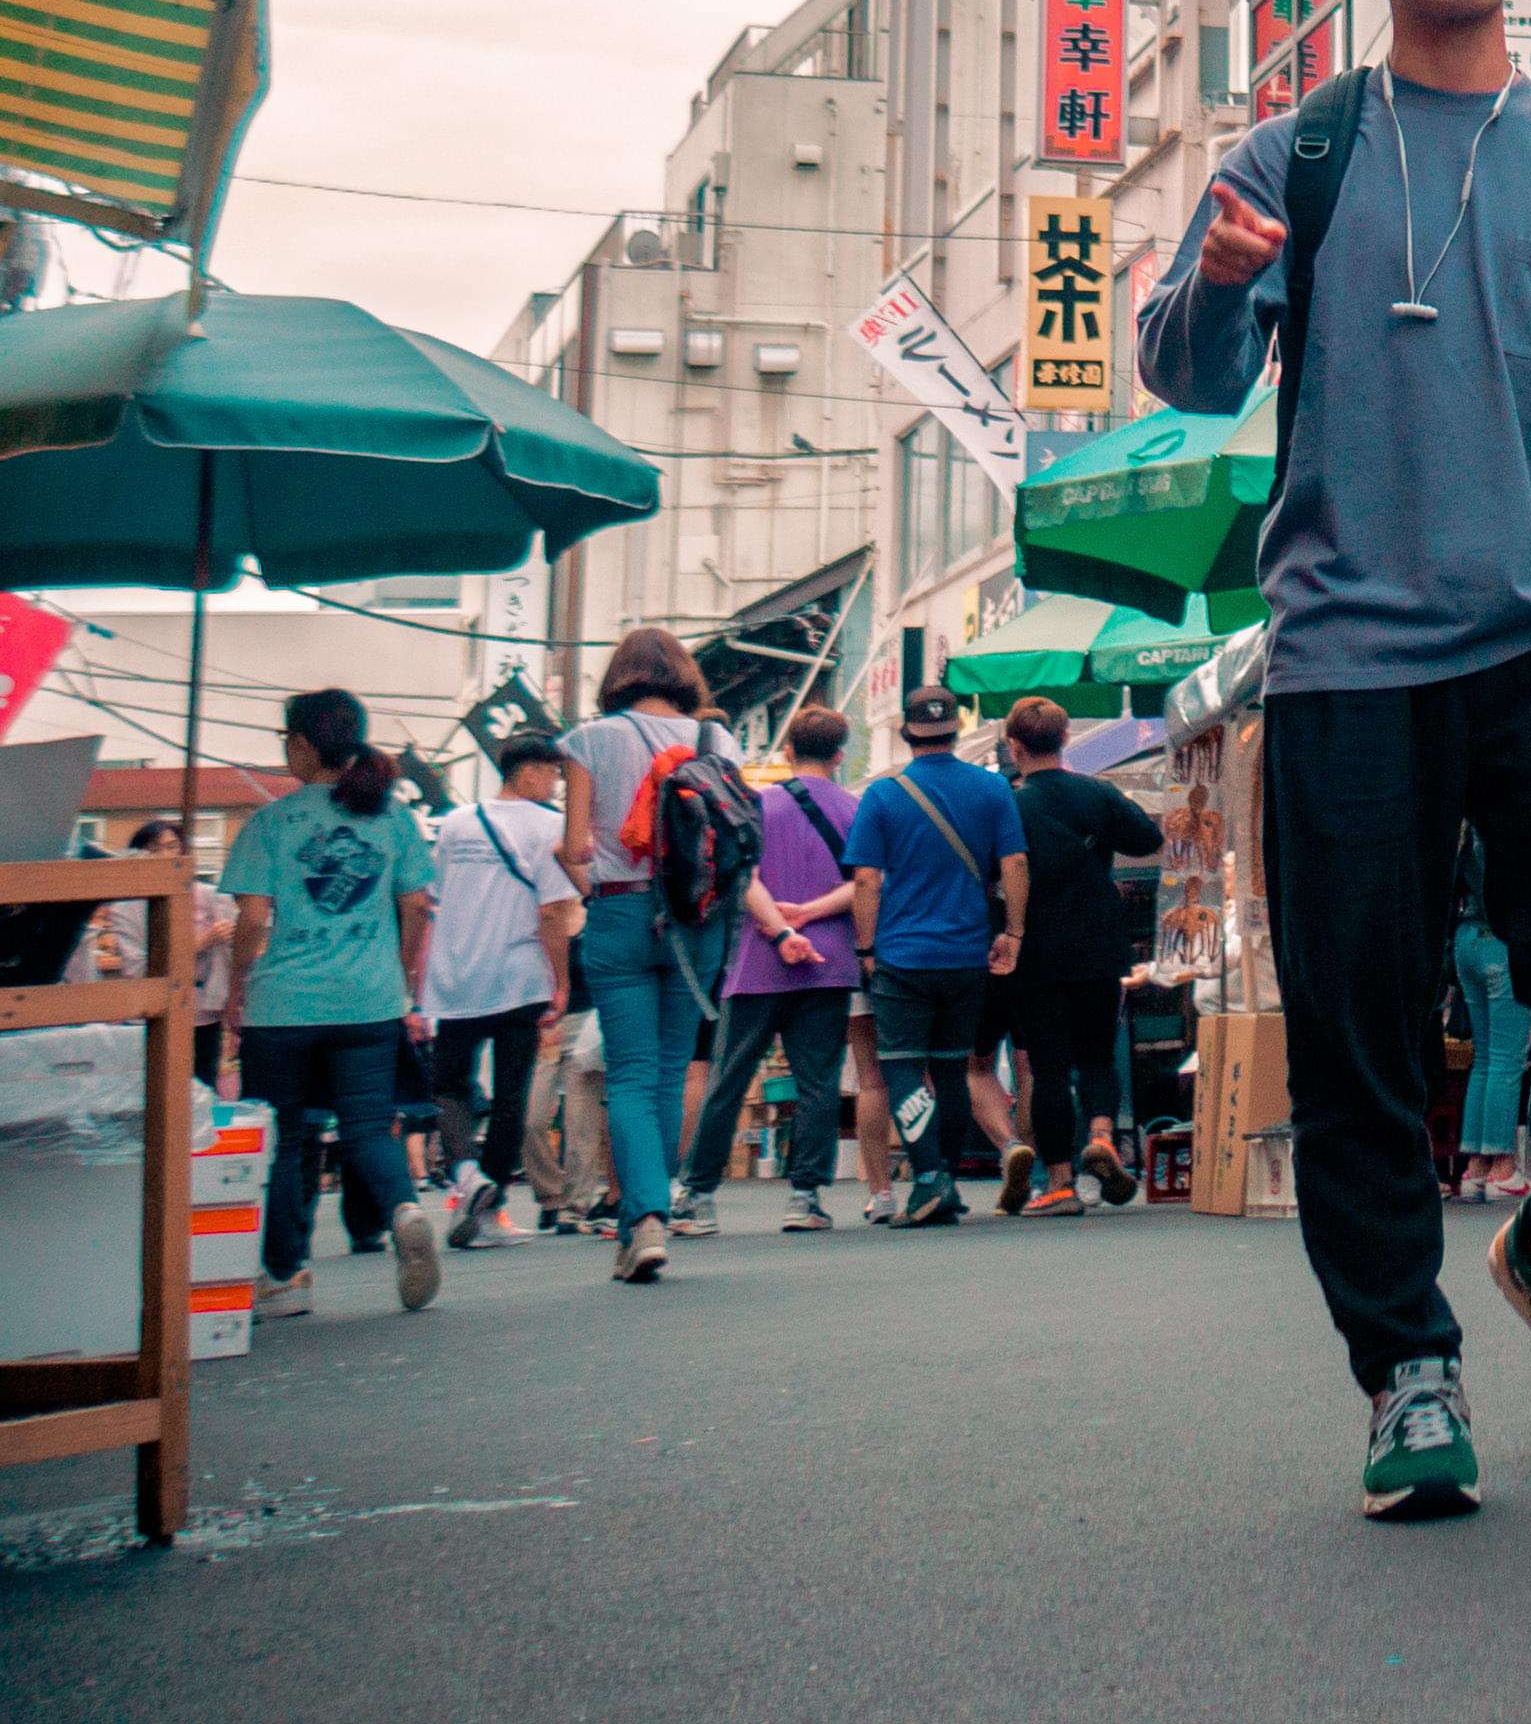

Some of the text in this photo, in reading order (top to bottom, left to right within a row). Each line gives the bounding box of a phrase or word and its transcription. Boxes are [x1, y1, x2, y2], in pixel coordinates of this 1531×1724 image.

[1033, 213, 1106, 343] 茶
[1137, 647, 1209, 666] CAPTAIN
[896, 1086, 929, 1130] NIKE
